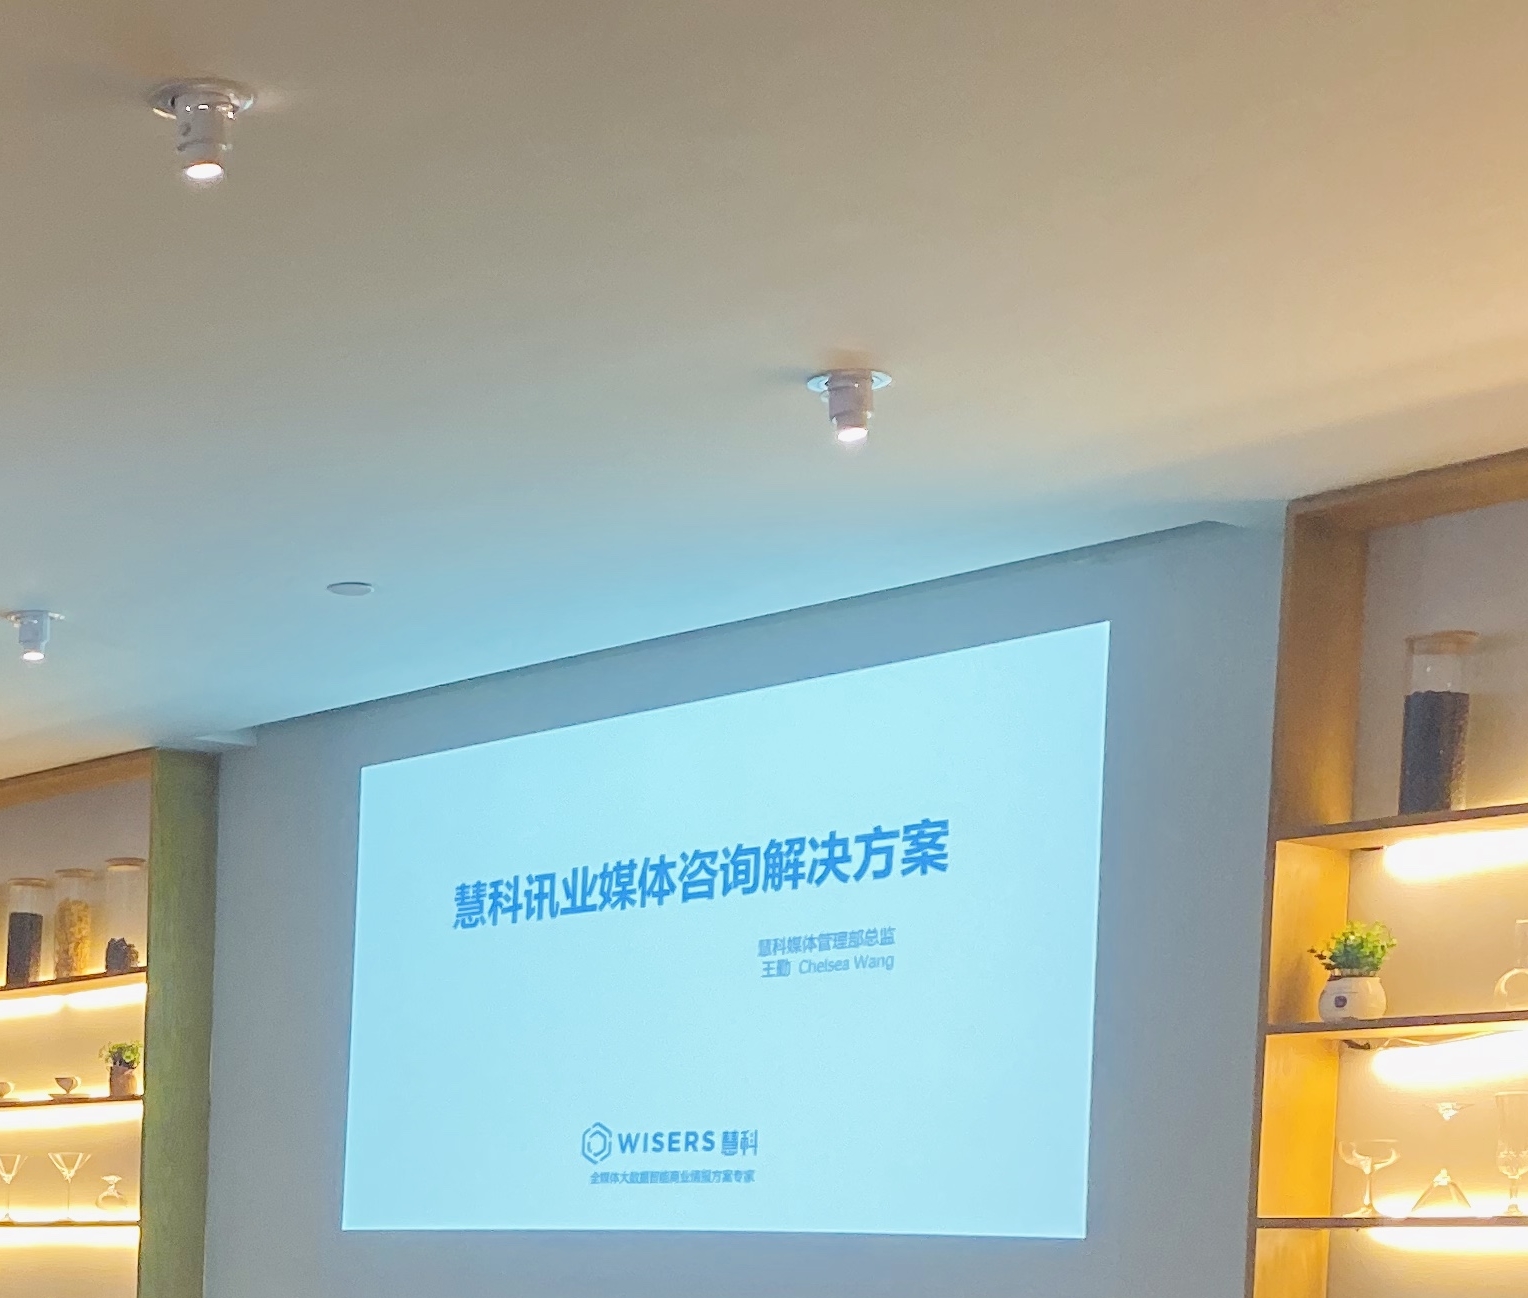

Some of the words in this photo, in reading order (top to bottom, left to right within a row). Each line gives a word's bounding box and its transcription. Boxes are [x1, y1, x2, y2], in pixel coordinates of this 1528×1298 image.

[452, 818, 950, 930] 慧科讯业媒体咨询解决方案
[757, 926, 896, 957] 慧科媒体管理部总监
[798, 958, 850, 975] Chelsea
[853, 954, 895, 971] Wang
[617, 1130, 716, 1154] WISERS
[721, 1129, 759, 1156] 慧科
